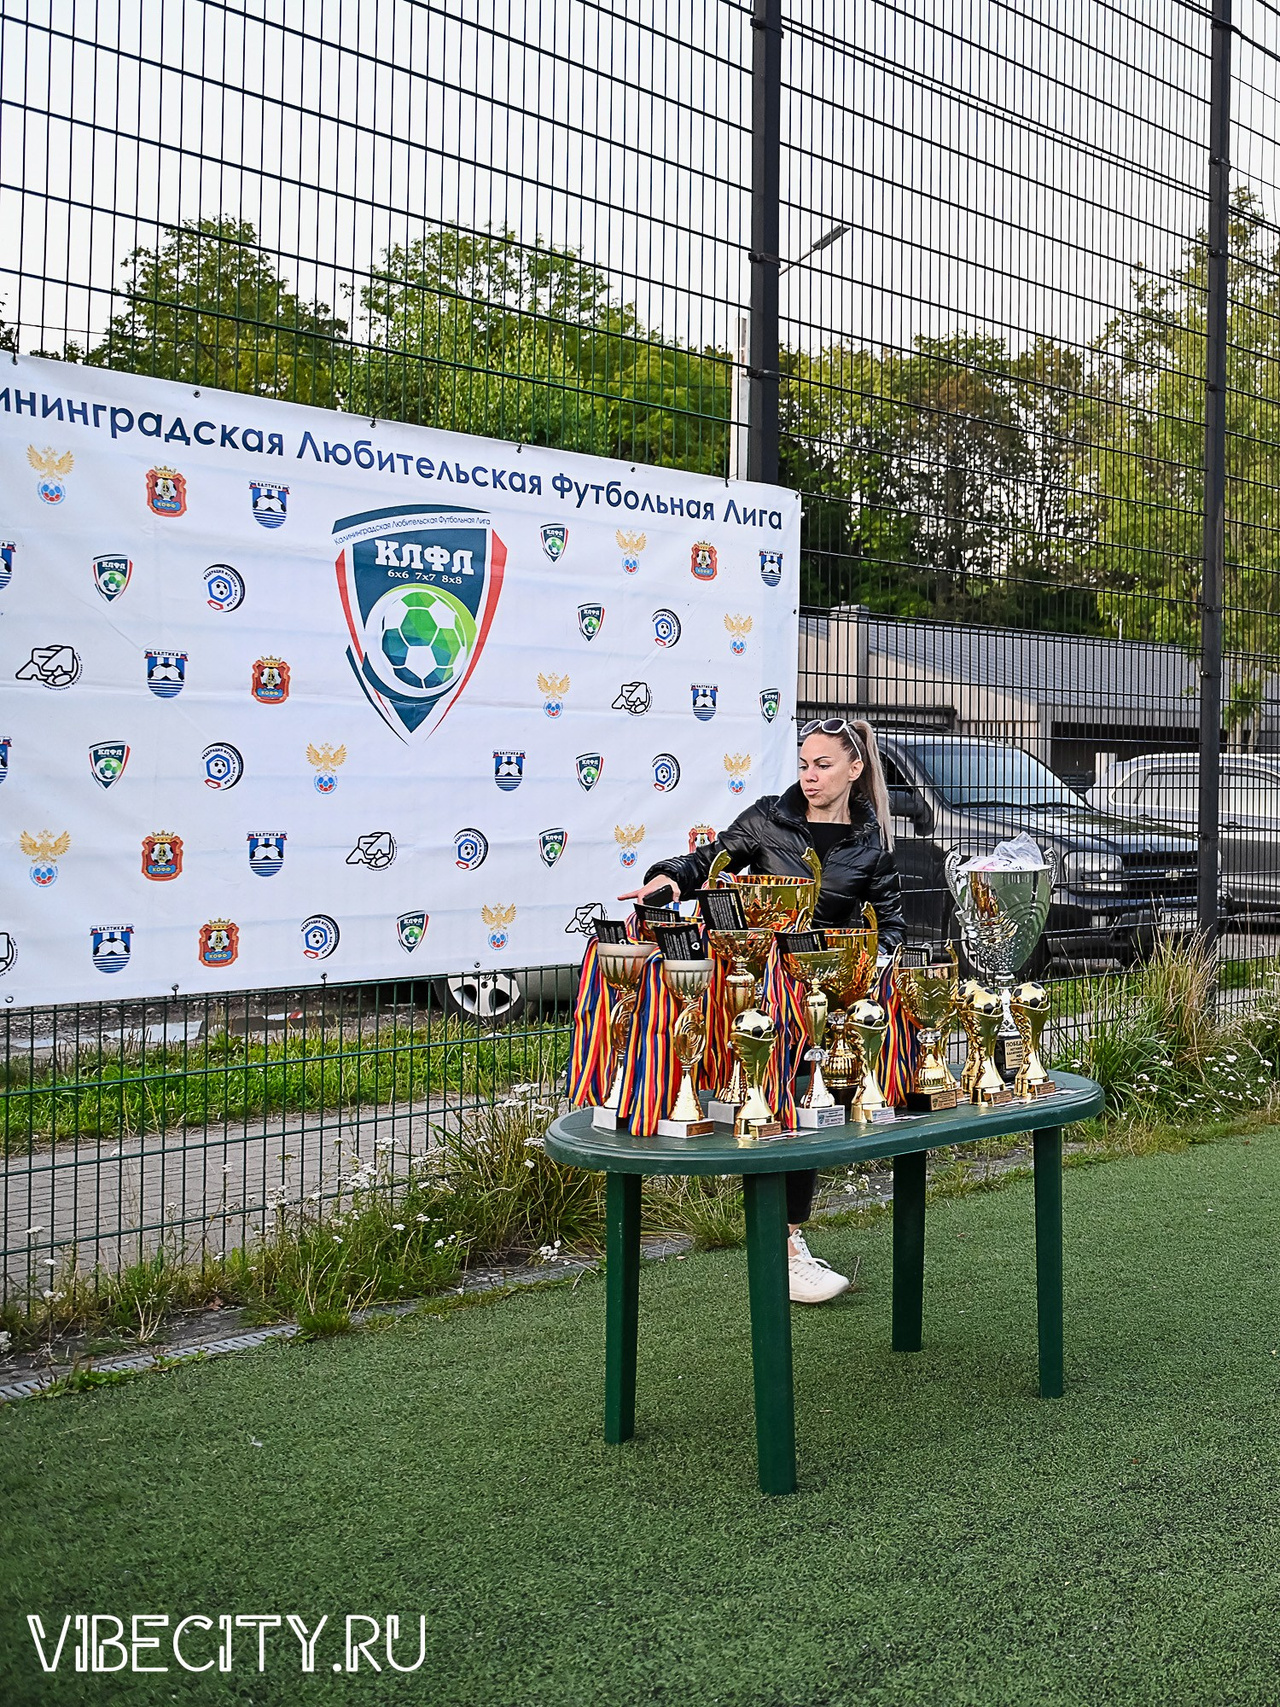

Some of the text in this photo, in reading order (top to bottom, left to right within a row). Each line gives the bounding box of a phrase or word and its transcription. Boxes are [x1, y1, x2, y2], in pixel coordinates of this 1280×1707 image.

[296, 431, 542, 495] Любительская
[551, 472, 715, 520] Футбольная
[723, 499, 782, 530] Лига
[257, 482, 282, 490] БАЛТИКА
[333, 515, 491, 546] Калининградская Любительская Футбольная Лига
[546, 529, 564, 537] КЛФЛ
[374, 539, 475, 576] КЛФЛ
[102, 561, 126, 570] КЛФЛ
[387, 569, 463, 585] 6x6 7x7 8x8
[153, 650, 180, 658] БАЛТИКА
[403, 917, 423, 925] КЛФЛ
